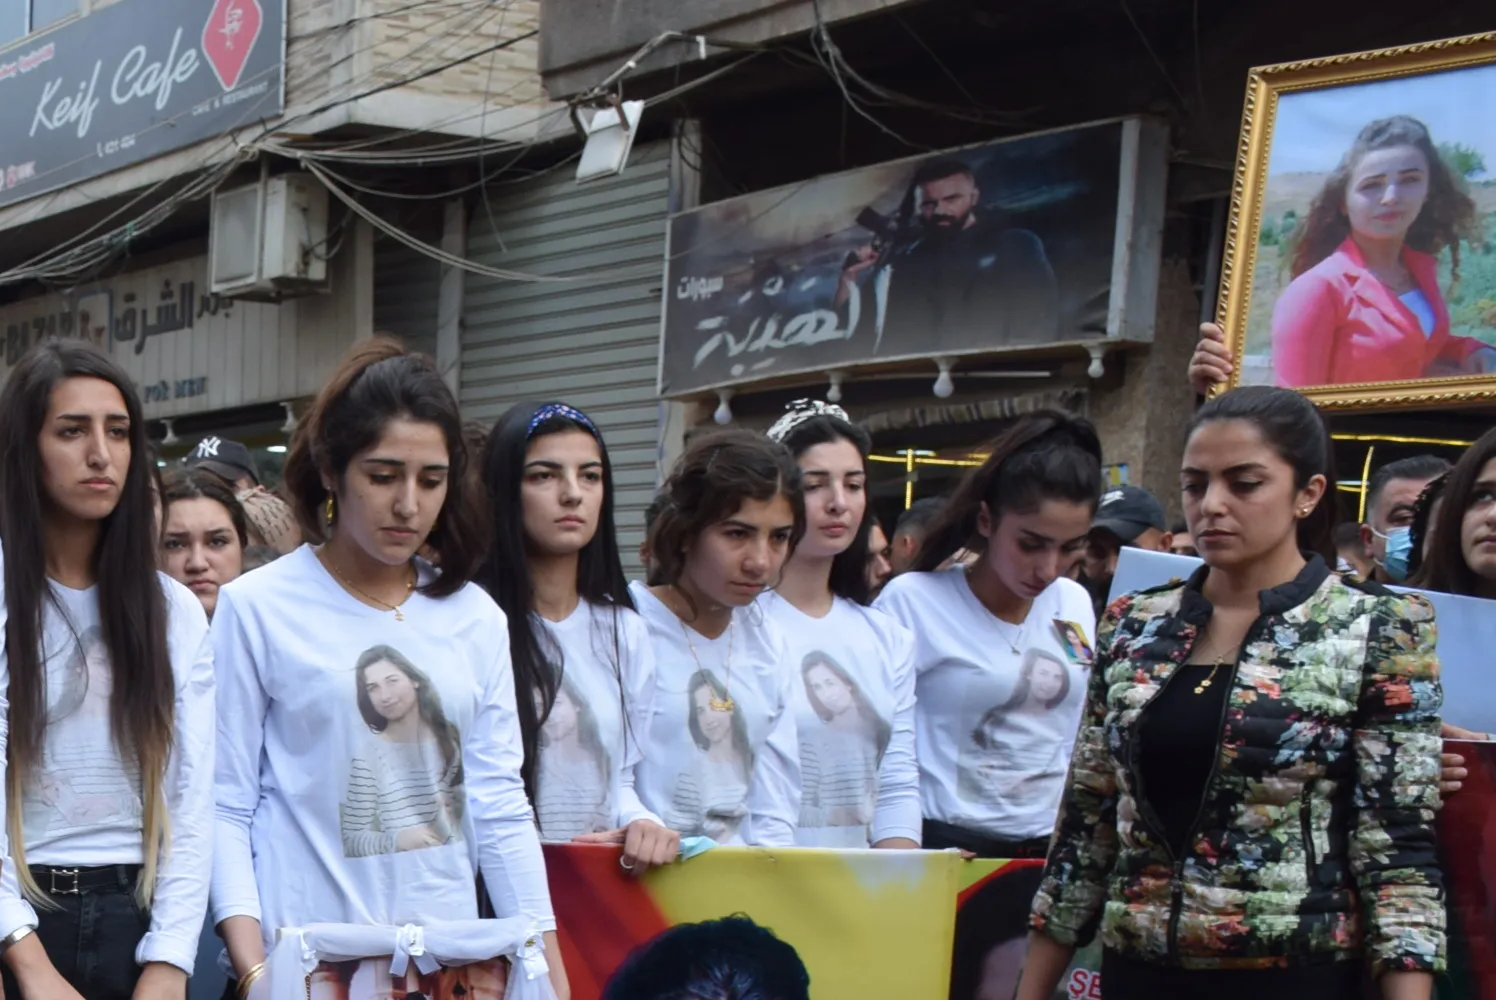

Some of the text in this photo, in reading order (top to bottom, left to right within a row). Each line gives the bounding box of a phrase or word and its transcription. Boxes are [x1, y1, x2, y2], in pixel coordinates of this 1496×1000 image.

[29, 26, 201, 138] Keif Cafe
[114, 279, 194, 355] الشرق
